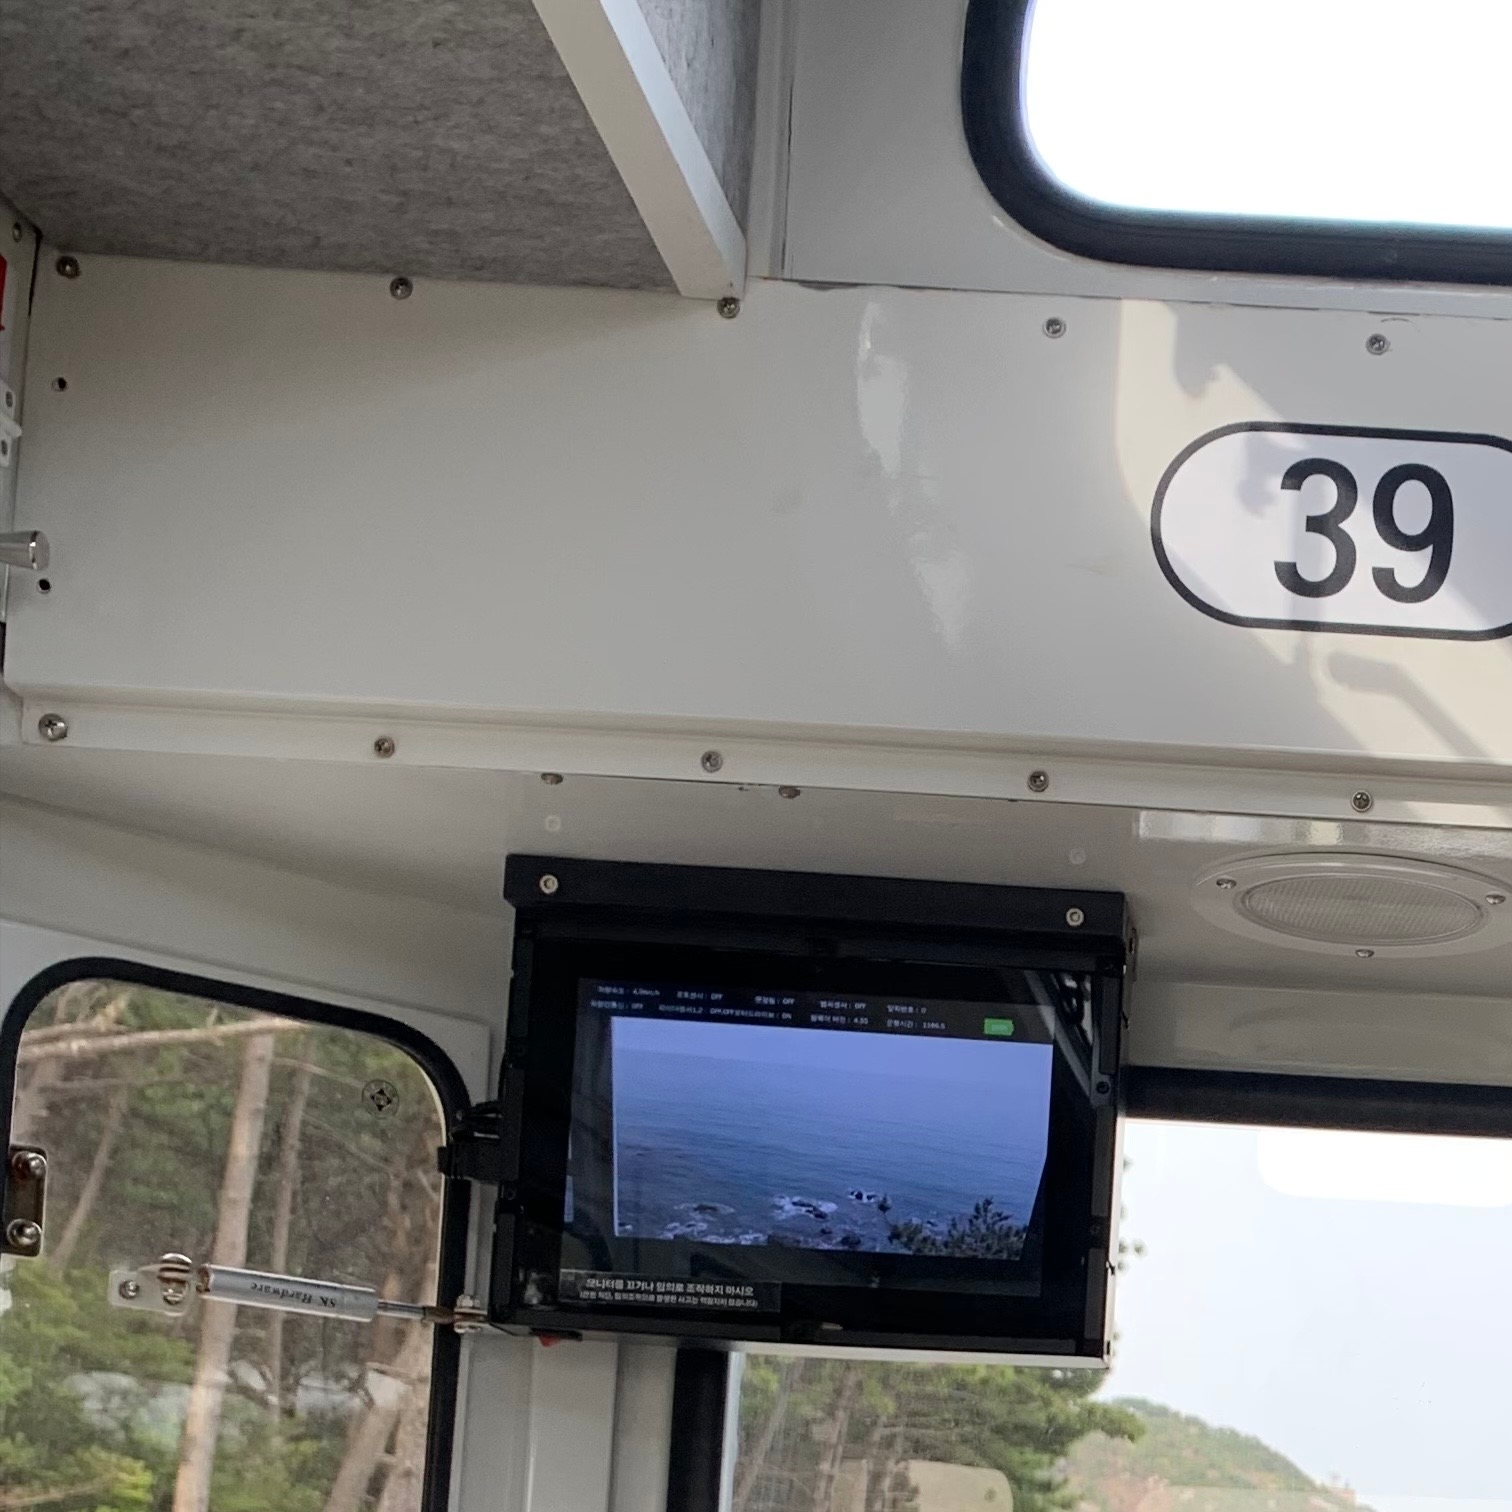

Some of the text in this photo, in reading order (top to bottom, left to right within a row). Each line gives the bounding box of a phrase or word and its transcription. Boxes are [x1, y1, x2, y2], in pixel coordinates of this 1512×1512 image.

[1274, 457, 1455, 604] 39
[251, 1283, 337, 1309] SK Hardware
[725, 1286, 755, 1297] 마시오
